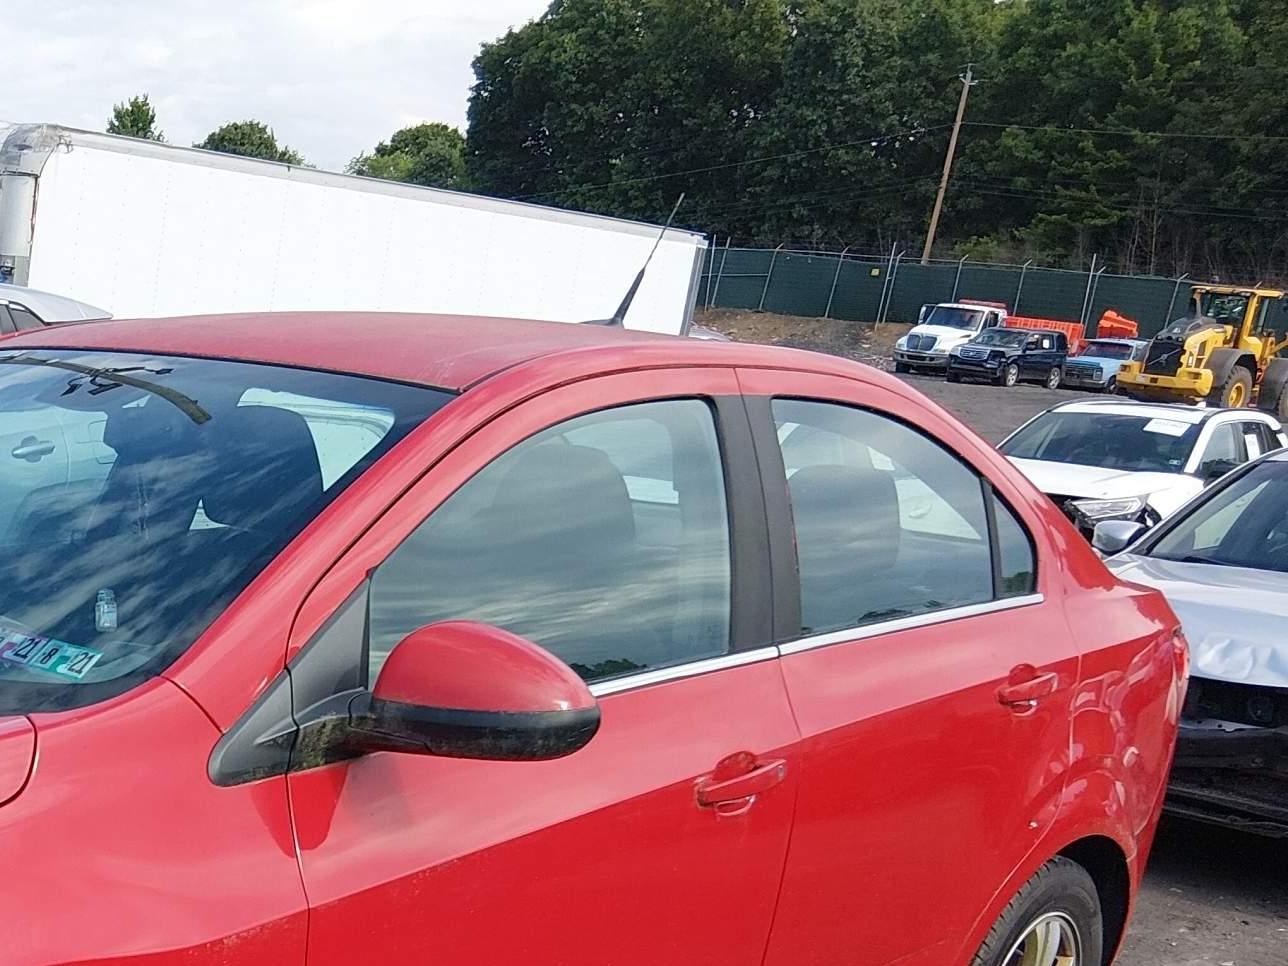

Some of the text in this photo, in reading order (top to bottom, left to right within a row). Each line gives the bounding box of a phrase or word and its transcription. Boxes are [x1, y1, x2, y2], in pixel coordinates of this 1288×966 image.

[13, 638, 41, 659] 21
[39, 647, 95, 675] 8 21
